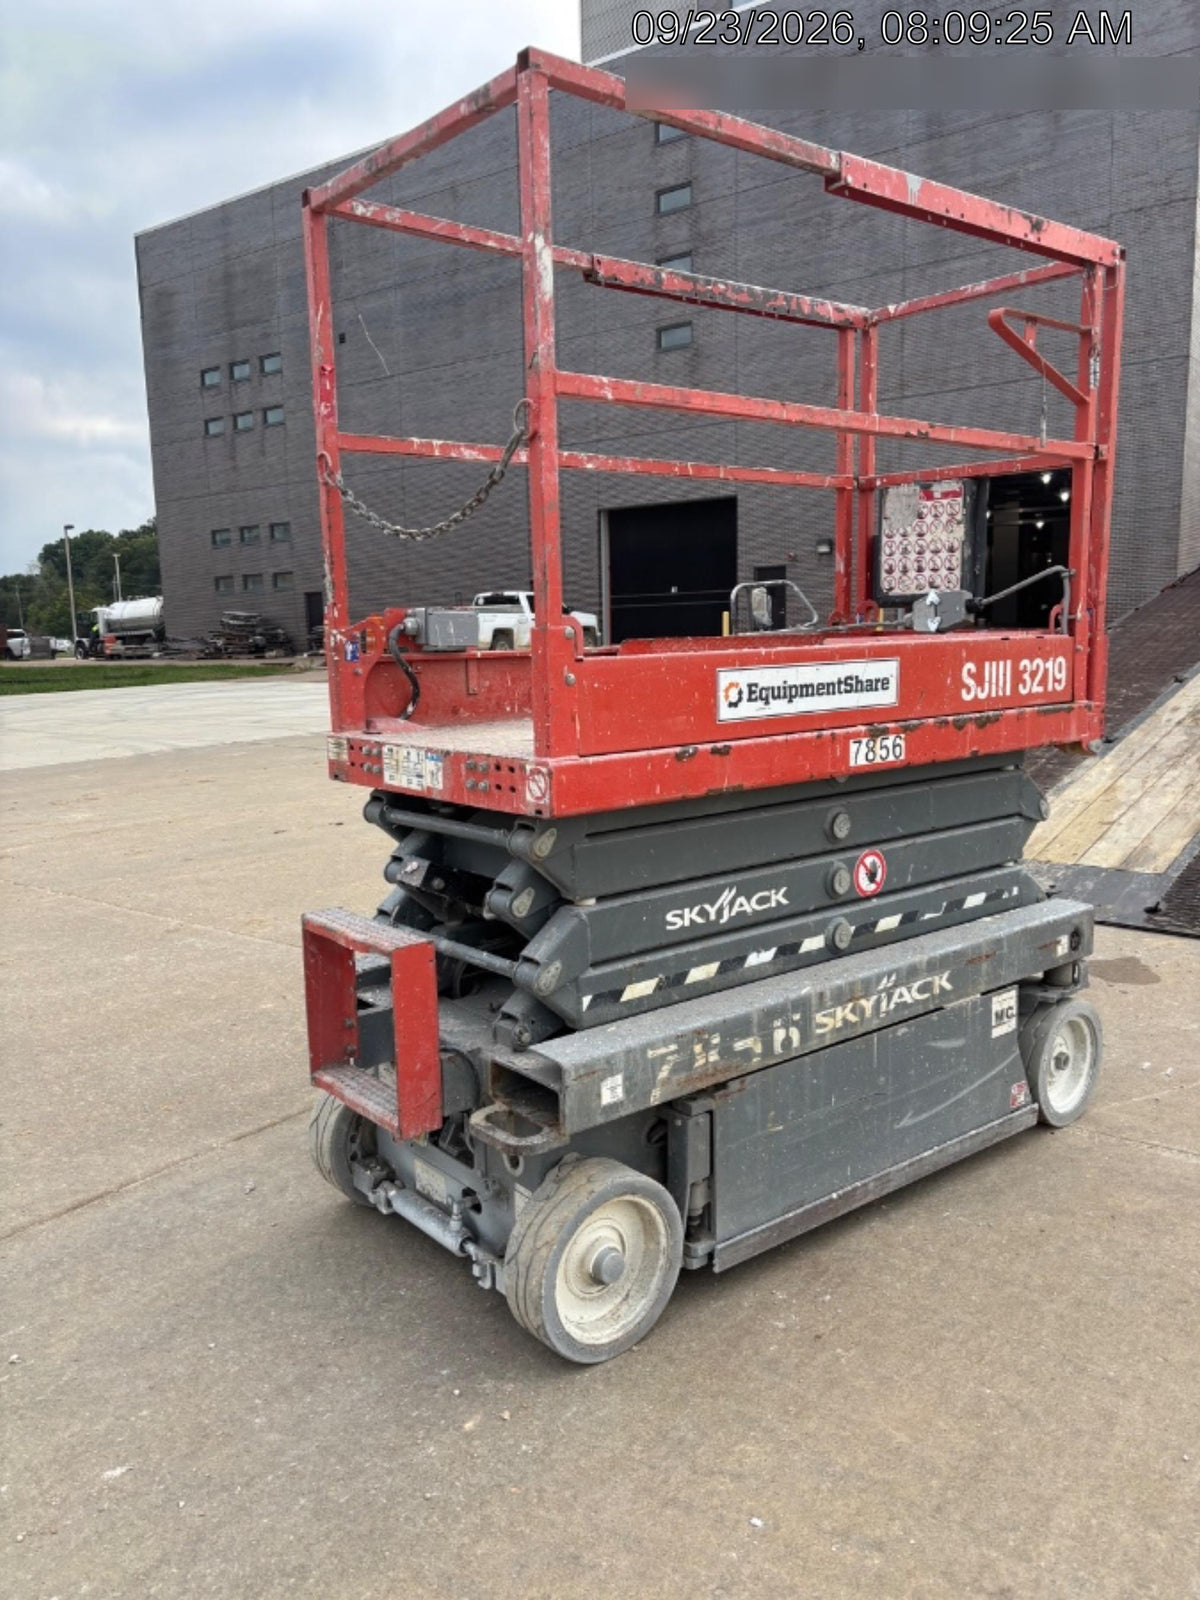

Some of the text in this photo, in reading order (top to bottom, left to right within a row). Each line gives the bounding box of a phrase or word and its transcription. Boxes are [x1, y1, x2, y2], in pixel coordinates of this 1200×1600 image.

[746, 675, 890, 706] EquipmentShare
[961, 656, 1066, 701] SJIII 3219
[852, 735, 903, 765] 7856
[665, 885, 790, 931] SKYJACK
[815, 970, 954, 1034] SKYJACK
